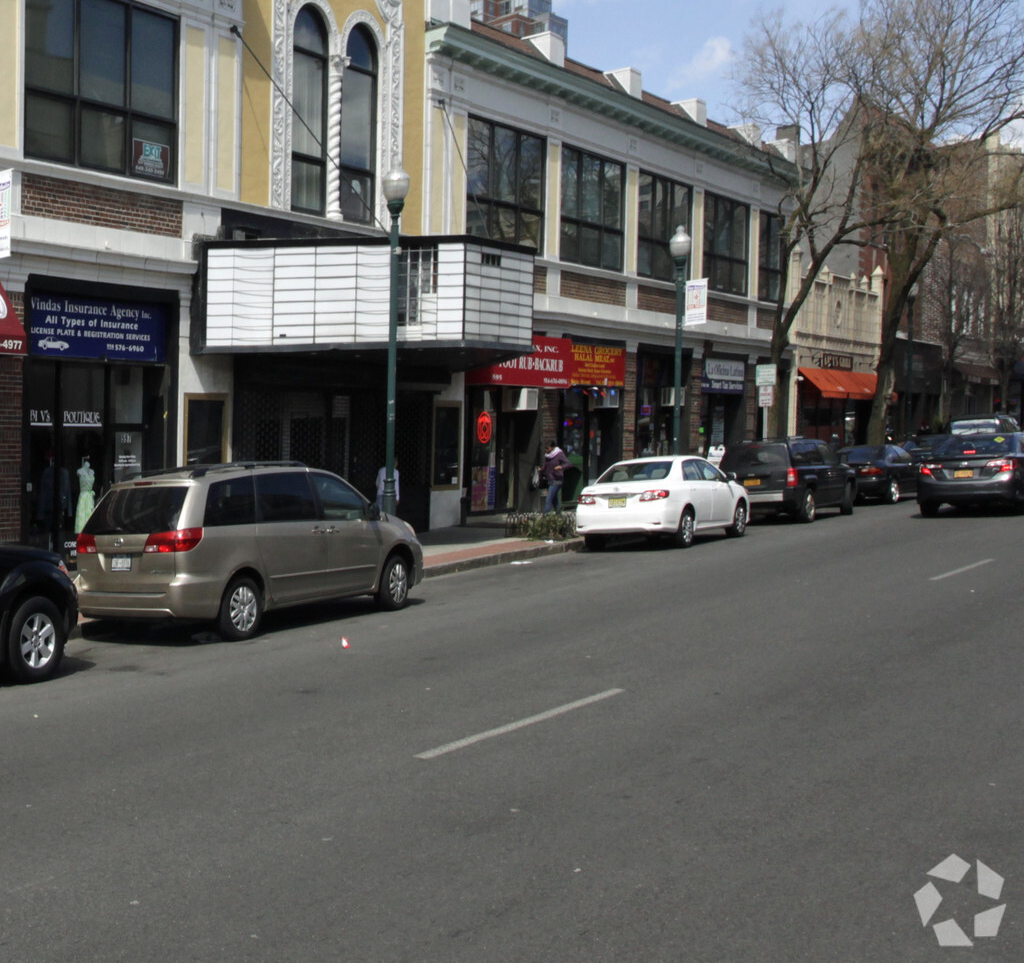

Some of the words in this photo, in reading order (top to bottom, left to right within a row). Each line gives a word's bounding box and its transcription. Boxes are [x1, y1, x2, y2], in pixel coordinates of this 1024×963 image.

[31, 296, 61, 312] Vindas
[64, 300, 107, 316] Insurance
[110, 304, 140, 321] Agency
[141, 310, 152, 320] Inc.
[45, 315, 58, 325] All
[61, 316, 85, 328] Types
[88, 319, 98, 327] of
[100, 319, 139, 331] Insurance
[30, 327, 55, 336] LICENSE
[56, 328, 75, 337] PLATE
[83, 330, 125, 340] REGISTRATION
[125, 333, 151, 342] SERVICES
[115, 343, 144, 353] 576-6960
[544, 345, 559, 353] INC.
[594, 346, 622, 356] GROCERY
[574, 353, 593, 362] HALAL
